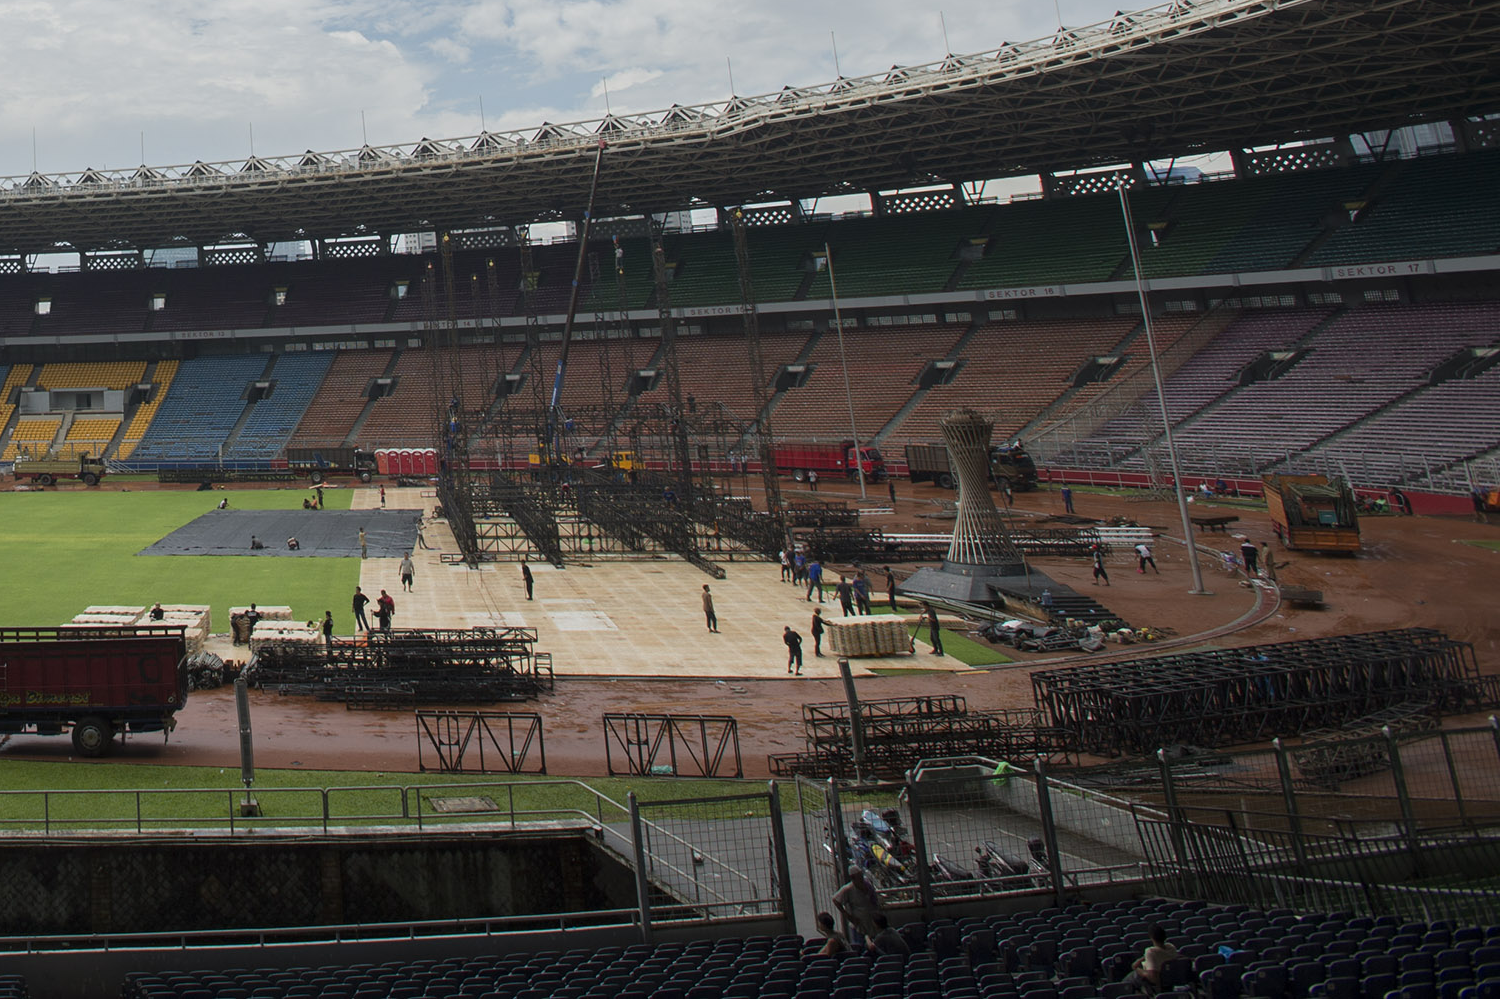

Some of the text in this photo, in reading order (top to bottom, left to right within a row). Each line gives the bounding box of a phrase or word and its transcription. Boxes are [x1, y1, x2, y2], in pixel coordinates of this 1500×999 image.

[1338, 264, 1419, 277] SEKTOR 17
[989, 289, 1037, 298] SEKTOR
[691, 308, 732, 316] SEKTOR
